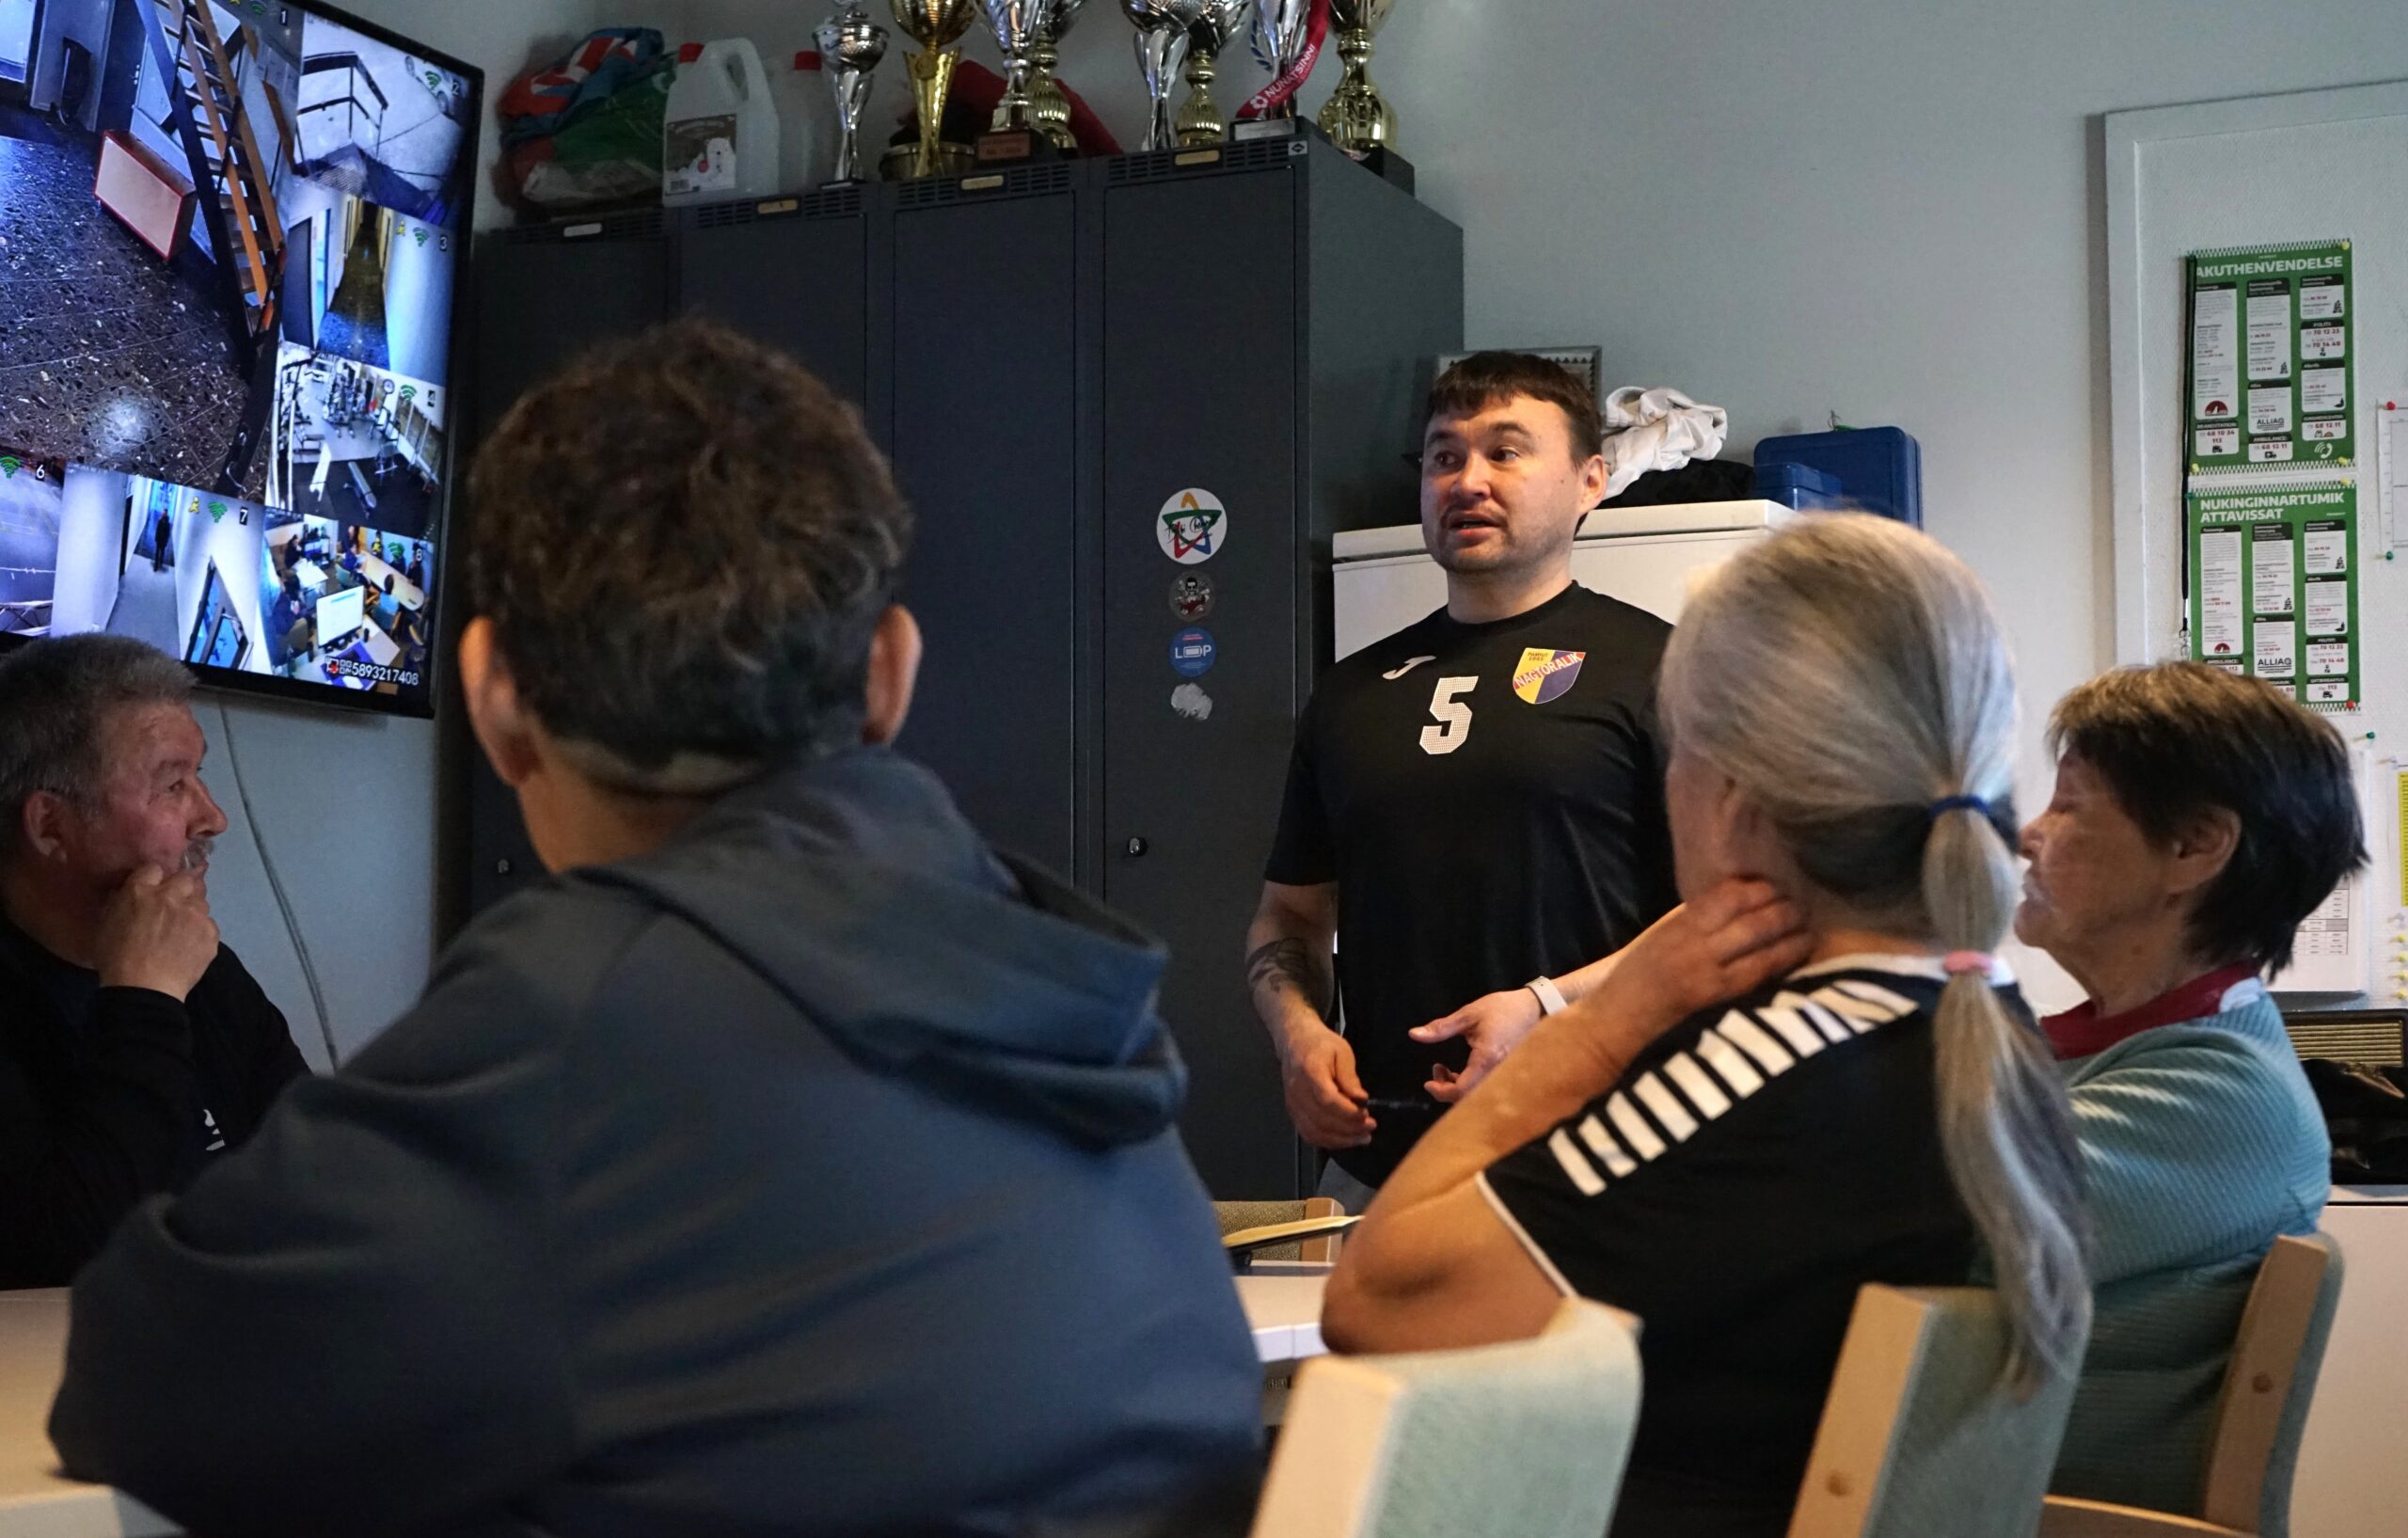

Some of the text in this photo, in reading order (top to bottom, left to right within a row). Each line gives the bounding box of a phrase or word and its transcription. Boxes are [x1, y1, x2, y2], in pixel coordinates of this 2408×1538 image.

[1264, 43, 1316, 98] NUNATSINNI
[2195, 256, 2343, 278] AKUTHENVENDELSE
[2257, 417, 2285, 425] ALLIAQ
[36, 465, 45, 479] 6
[2200, 492, 2345, 511] NUKINGINNARTUMIK
[239, 509, 248, 523] 7
[2200, 508, 2284, 523] ATTAVISSAT
[1514, 652, 1583, 687] NAGTORALIK
[2258, 657, 2292, 666] ALLIAQ
[352, 662, 419, 686] 5893217408
[1419, 675, 1479, 754] 5
